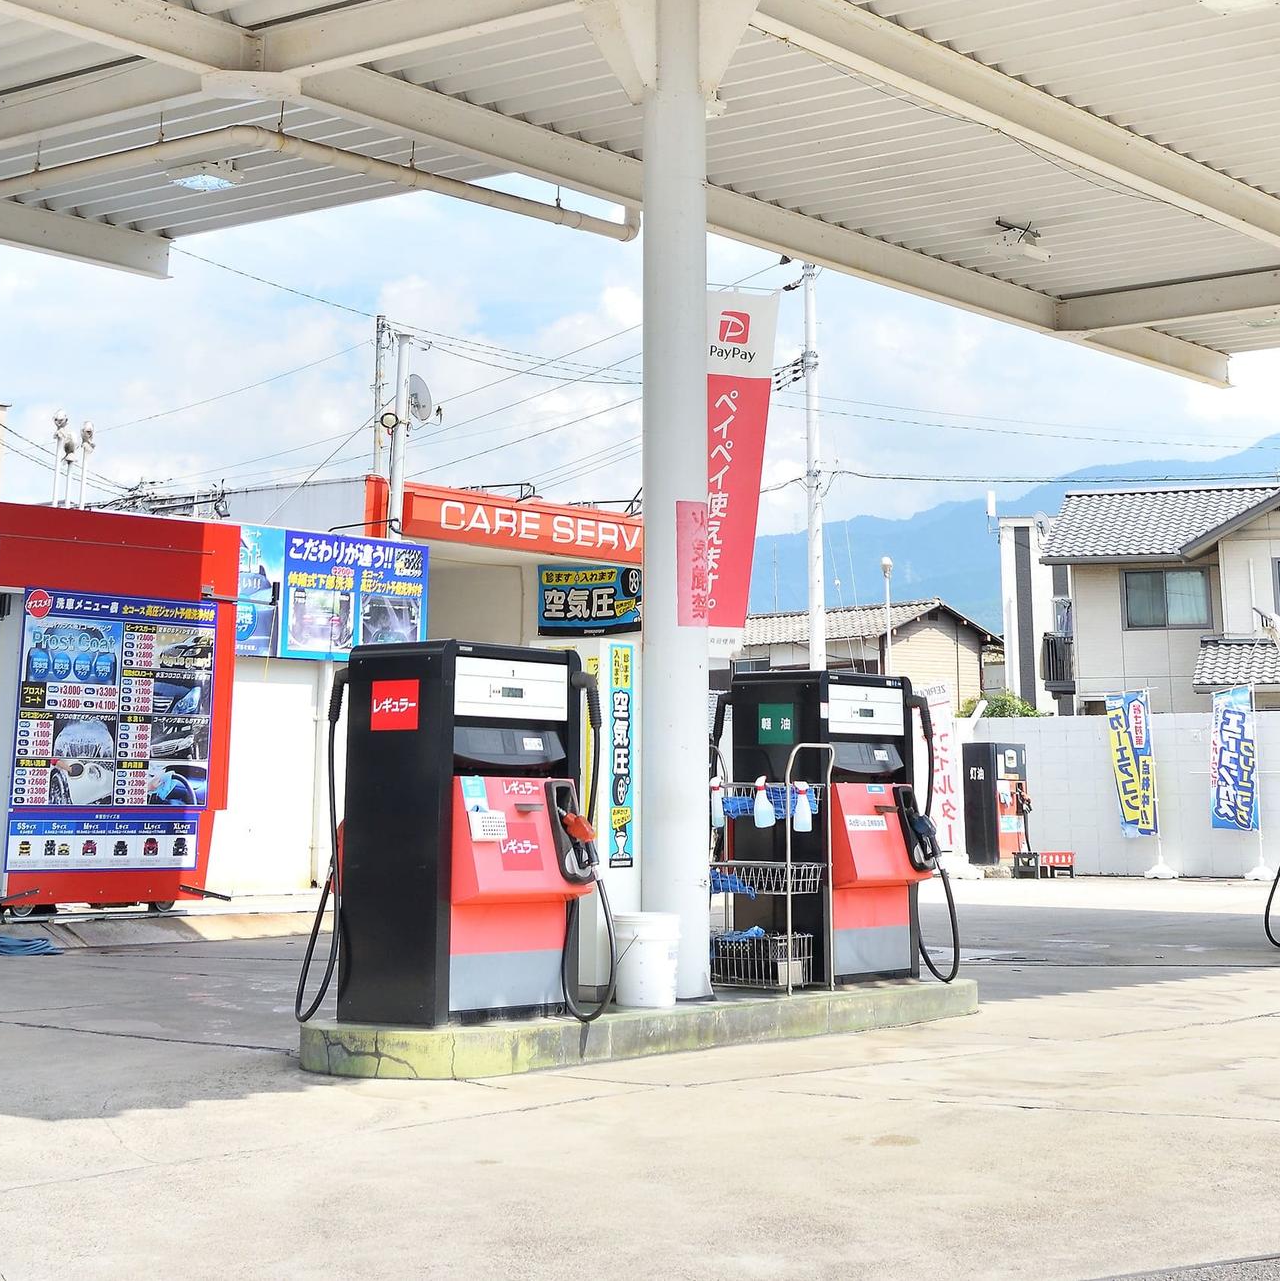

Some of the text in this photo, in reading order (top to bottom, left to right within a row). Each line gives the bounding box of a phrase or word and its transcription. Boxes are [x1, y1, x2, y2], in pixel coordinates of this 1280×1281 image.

[710, 345, 756, 363] PayPay
[440, 500, 642, 552] CARE SERV
[289, 537, 393, 569] こだわりが違う!!
[580, 571, 615, 582] 入れます
[544, 588, 615, 618] 空気圧
[23, 687, 45, 695] プロスト
[374, 697, 416, 713] レギュラー
[761, 718, 791, 730] 軽油
[613, 691, 630, 776] 空気圧
[970, 767, 984, 780] 灯油
[502, 781, 539, 795] レギュラー
[500, 840, 539, 854] レギュラー
